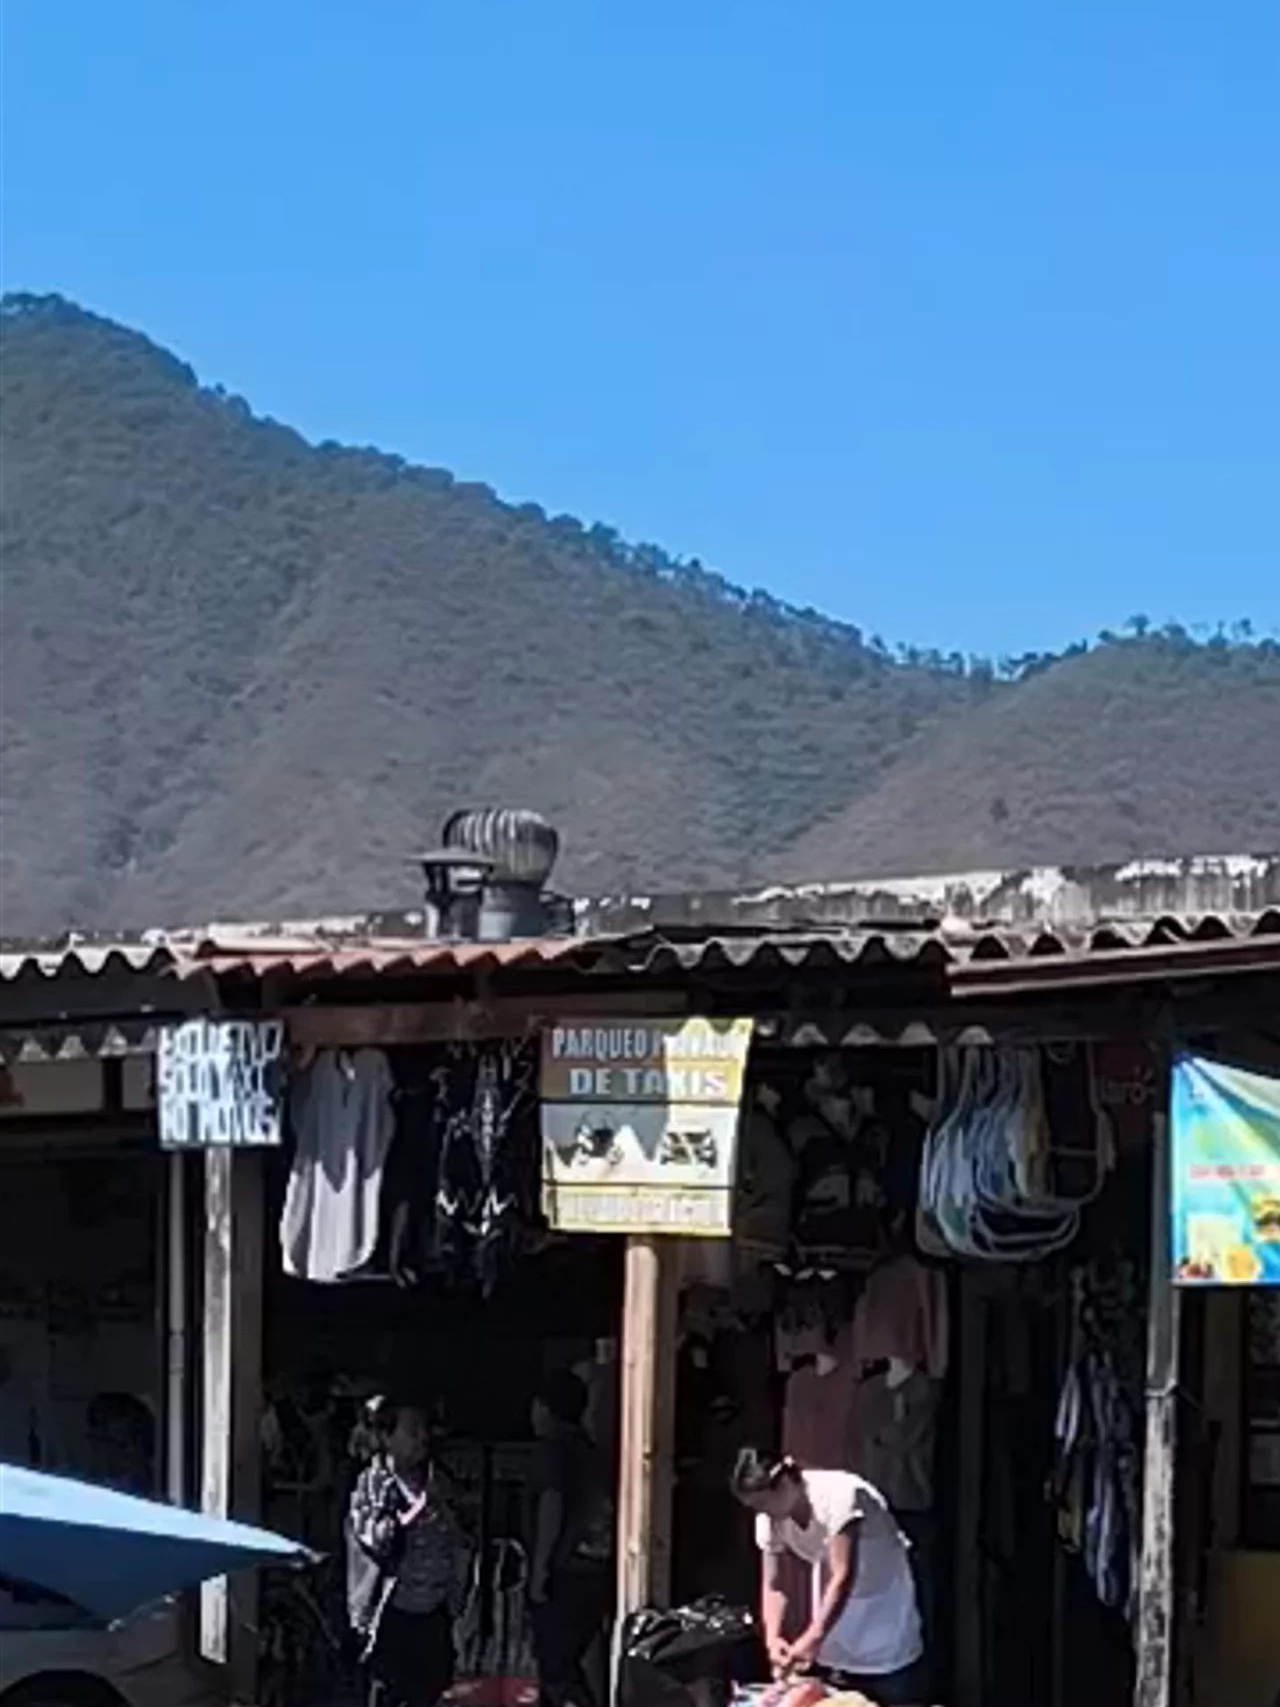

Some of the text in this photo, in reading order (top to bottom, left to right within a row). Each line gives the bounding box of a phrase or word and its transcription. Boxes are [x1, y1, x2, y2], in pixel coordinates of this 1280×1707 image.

[552, 1026, 649, 1060] PARQUEO
[568, 1067, 727, 1097] DE TAXIS
